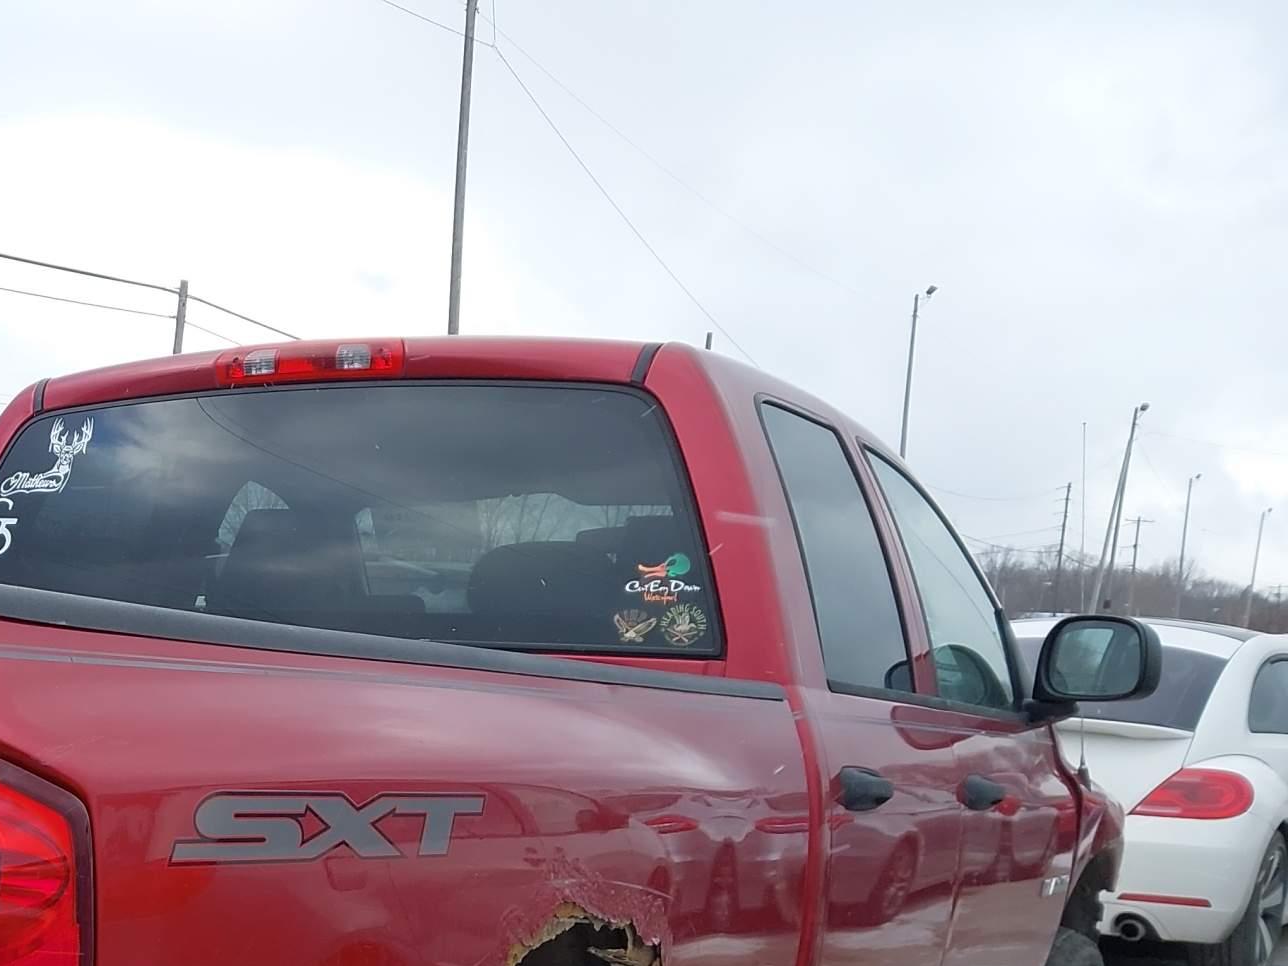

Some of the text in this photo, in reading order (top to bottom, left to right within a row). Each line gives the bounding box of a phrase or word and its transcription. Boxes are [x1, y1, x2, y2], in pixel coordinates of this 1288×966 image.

[660, 603, 690, 627] HEADING
[690, 605, 707, 631] SOUTH
[168, 790, 487, 867] SXT
